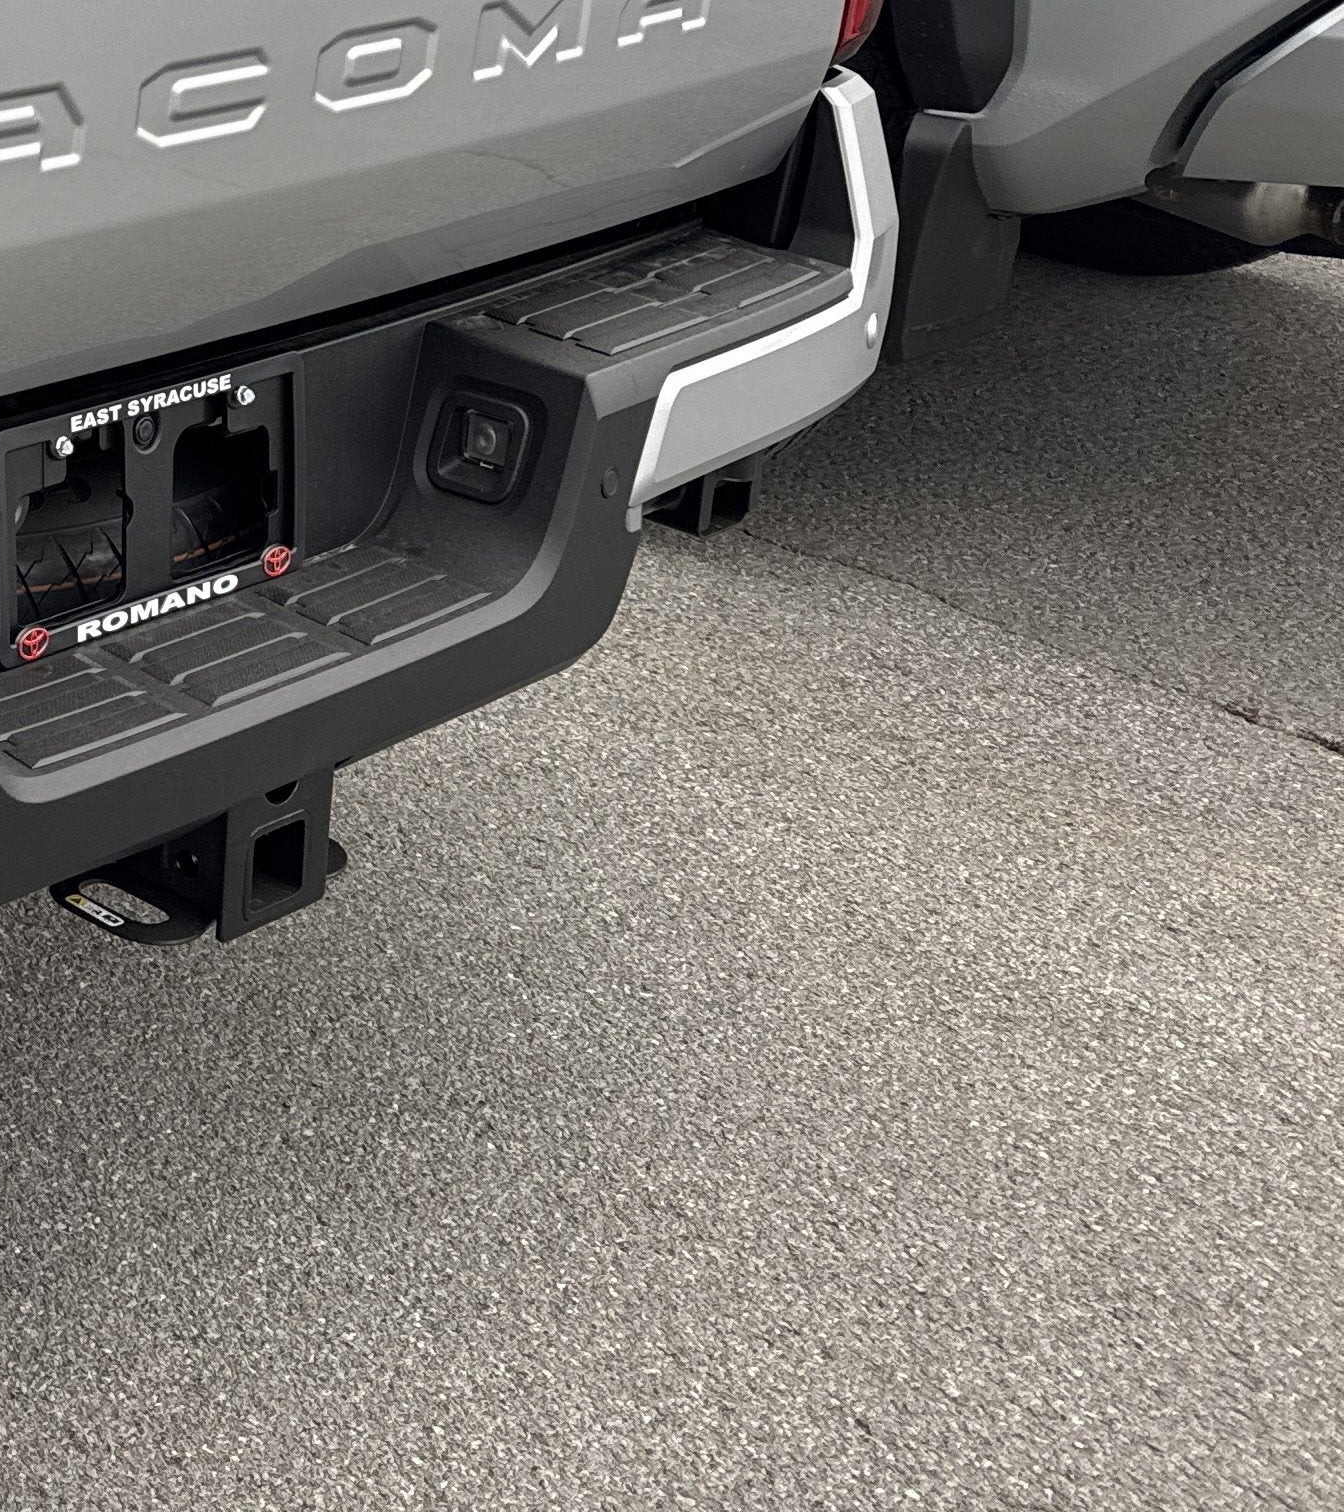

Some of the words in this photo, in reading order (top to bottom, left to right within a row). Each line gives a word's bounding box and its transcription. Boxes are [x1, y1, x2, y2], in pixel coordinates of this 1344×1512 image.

[70, 404, 122, 433] EAST
[127, 374, 232, 417] SYRACUSE
[77, 574, 239, 643] ROMANO
